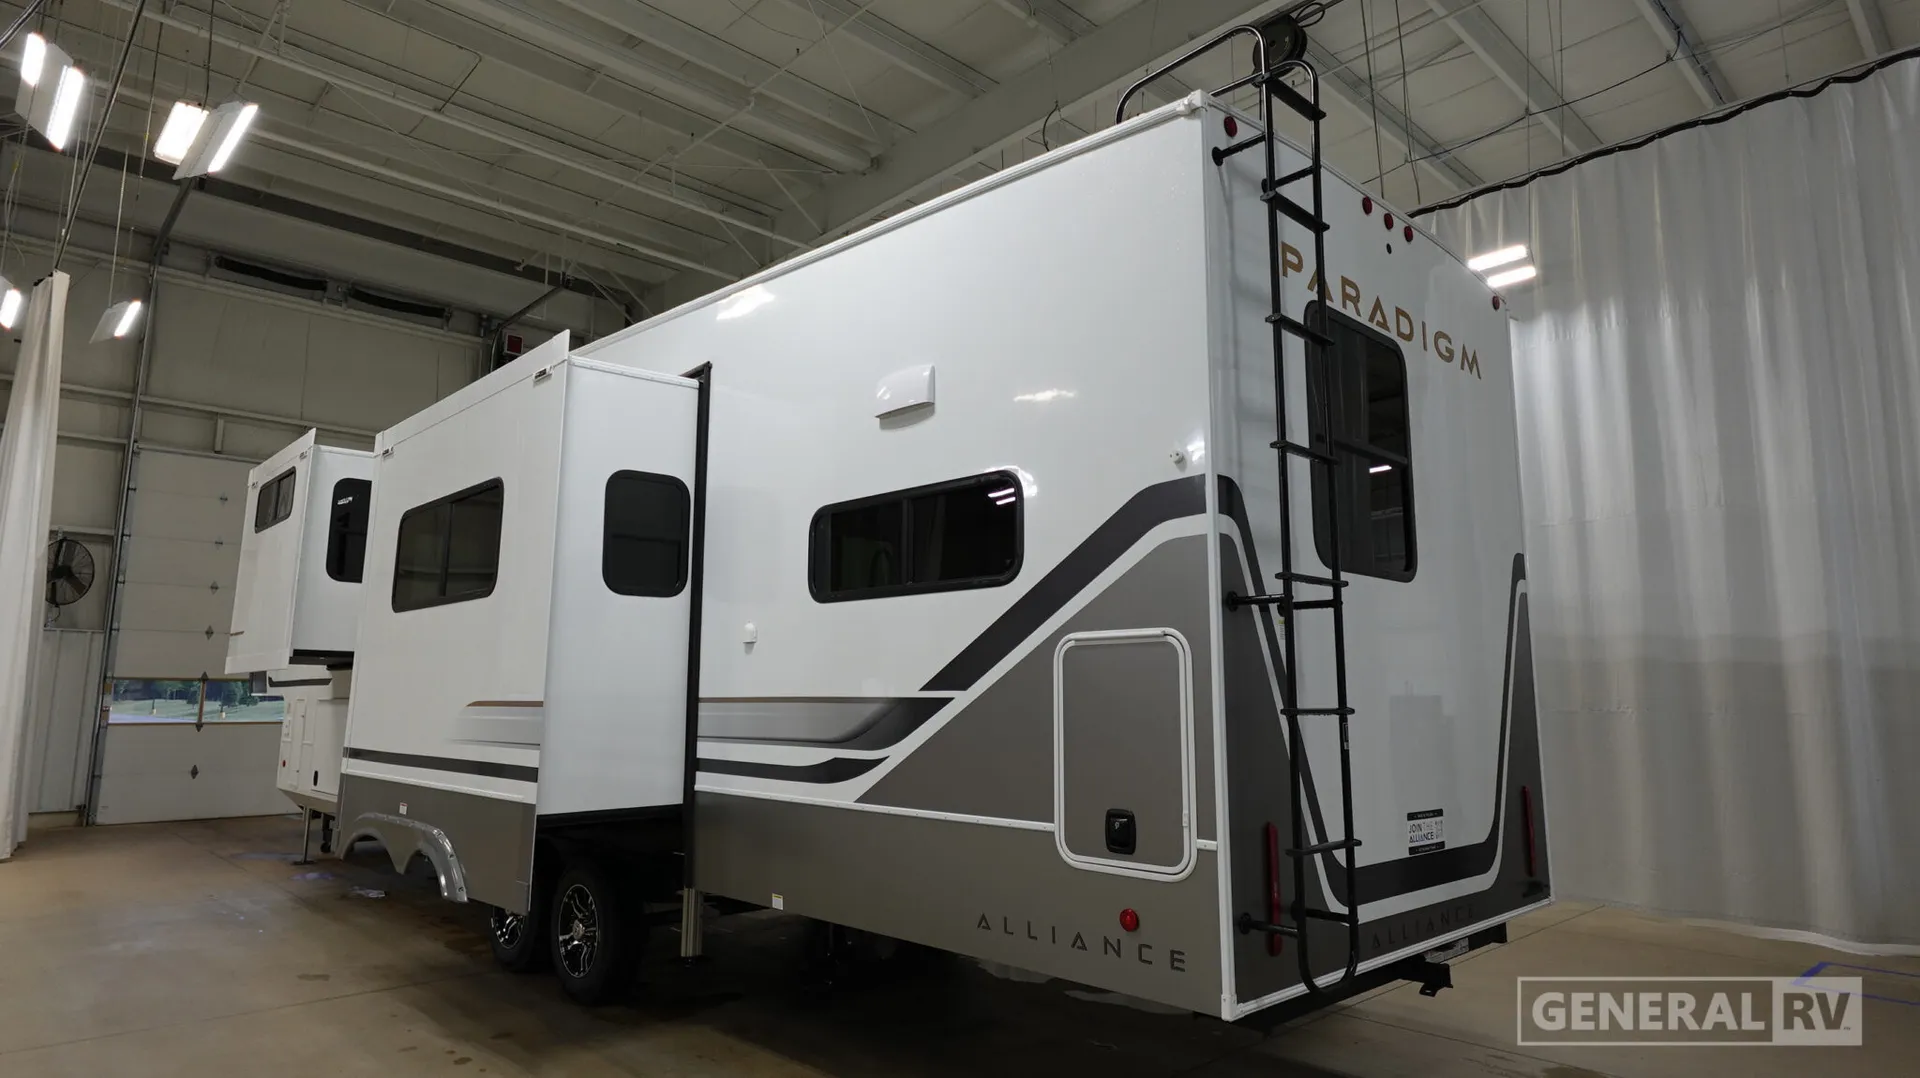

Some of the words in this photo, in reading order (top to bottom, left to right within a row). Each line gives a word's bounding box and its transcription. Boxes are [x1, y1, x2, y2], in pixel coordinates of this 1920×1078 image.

[1281, 241, 1482, 380] PARADIGM
[1408, 823, 1422, 834] JOIN
[1409, 832, 1434, 843] ALLIANCE
[977, 913, 1185, 973] ALLIANCE
[1372, 903, 1475, 949] ALLIANCE
